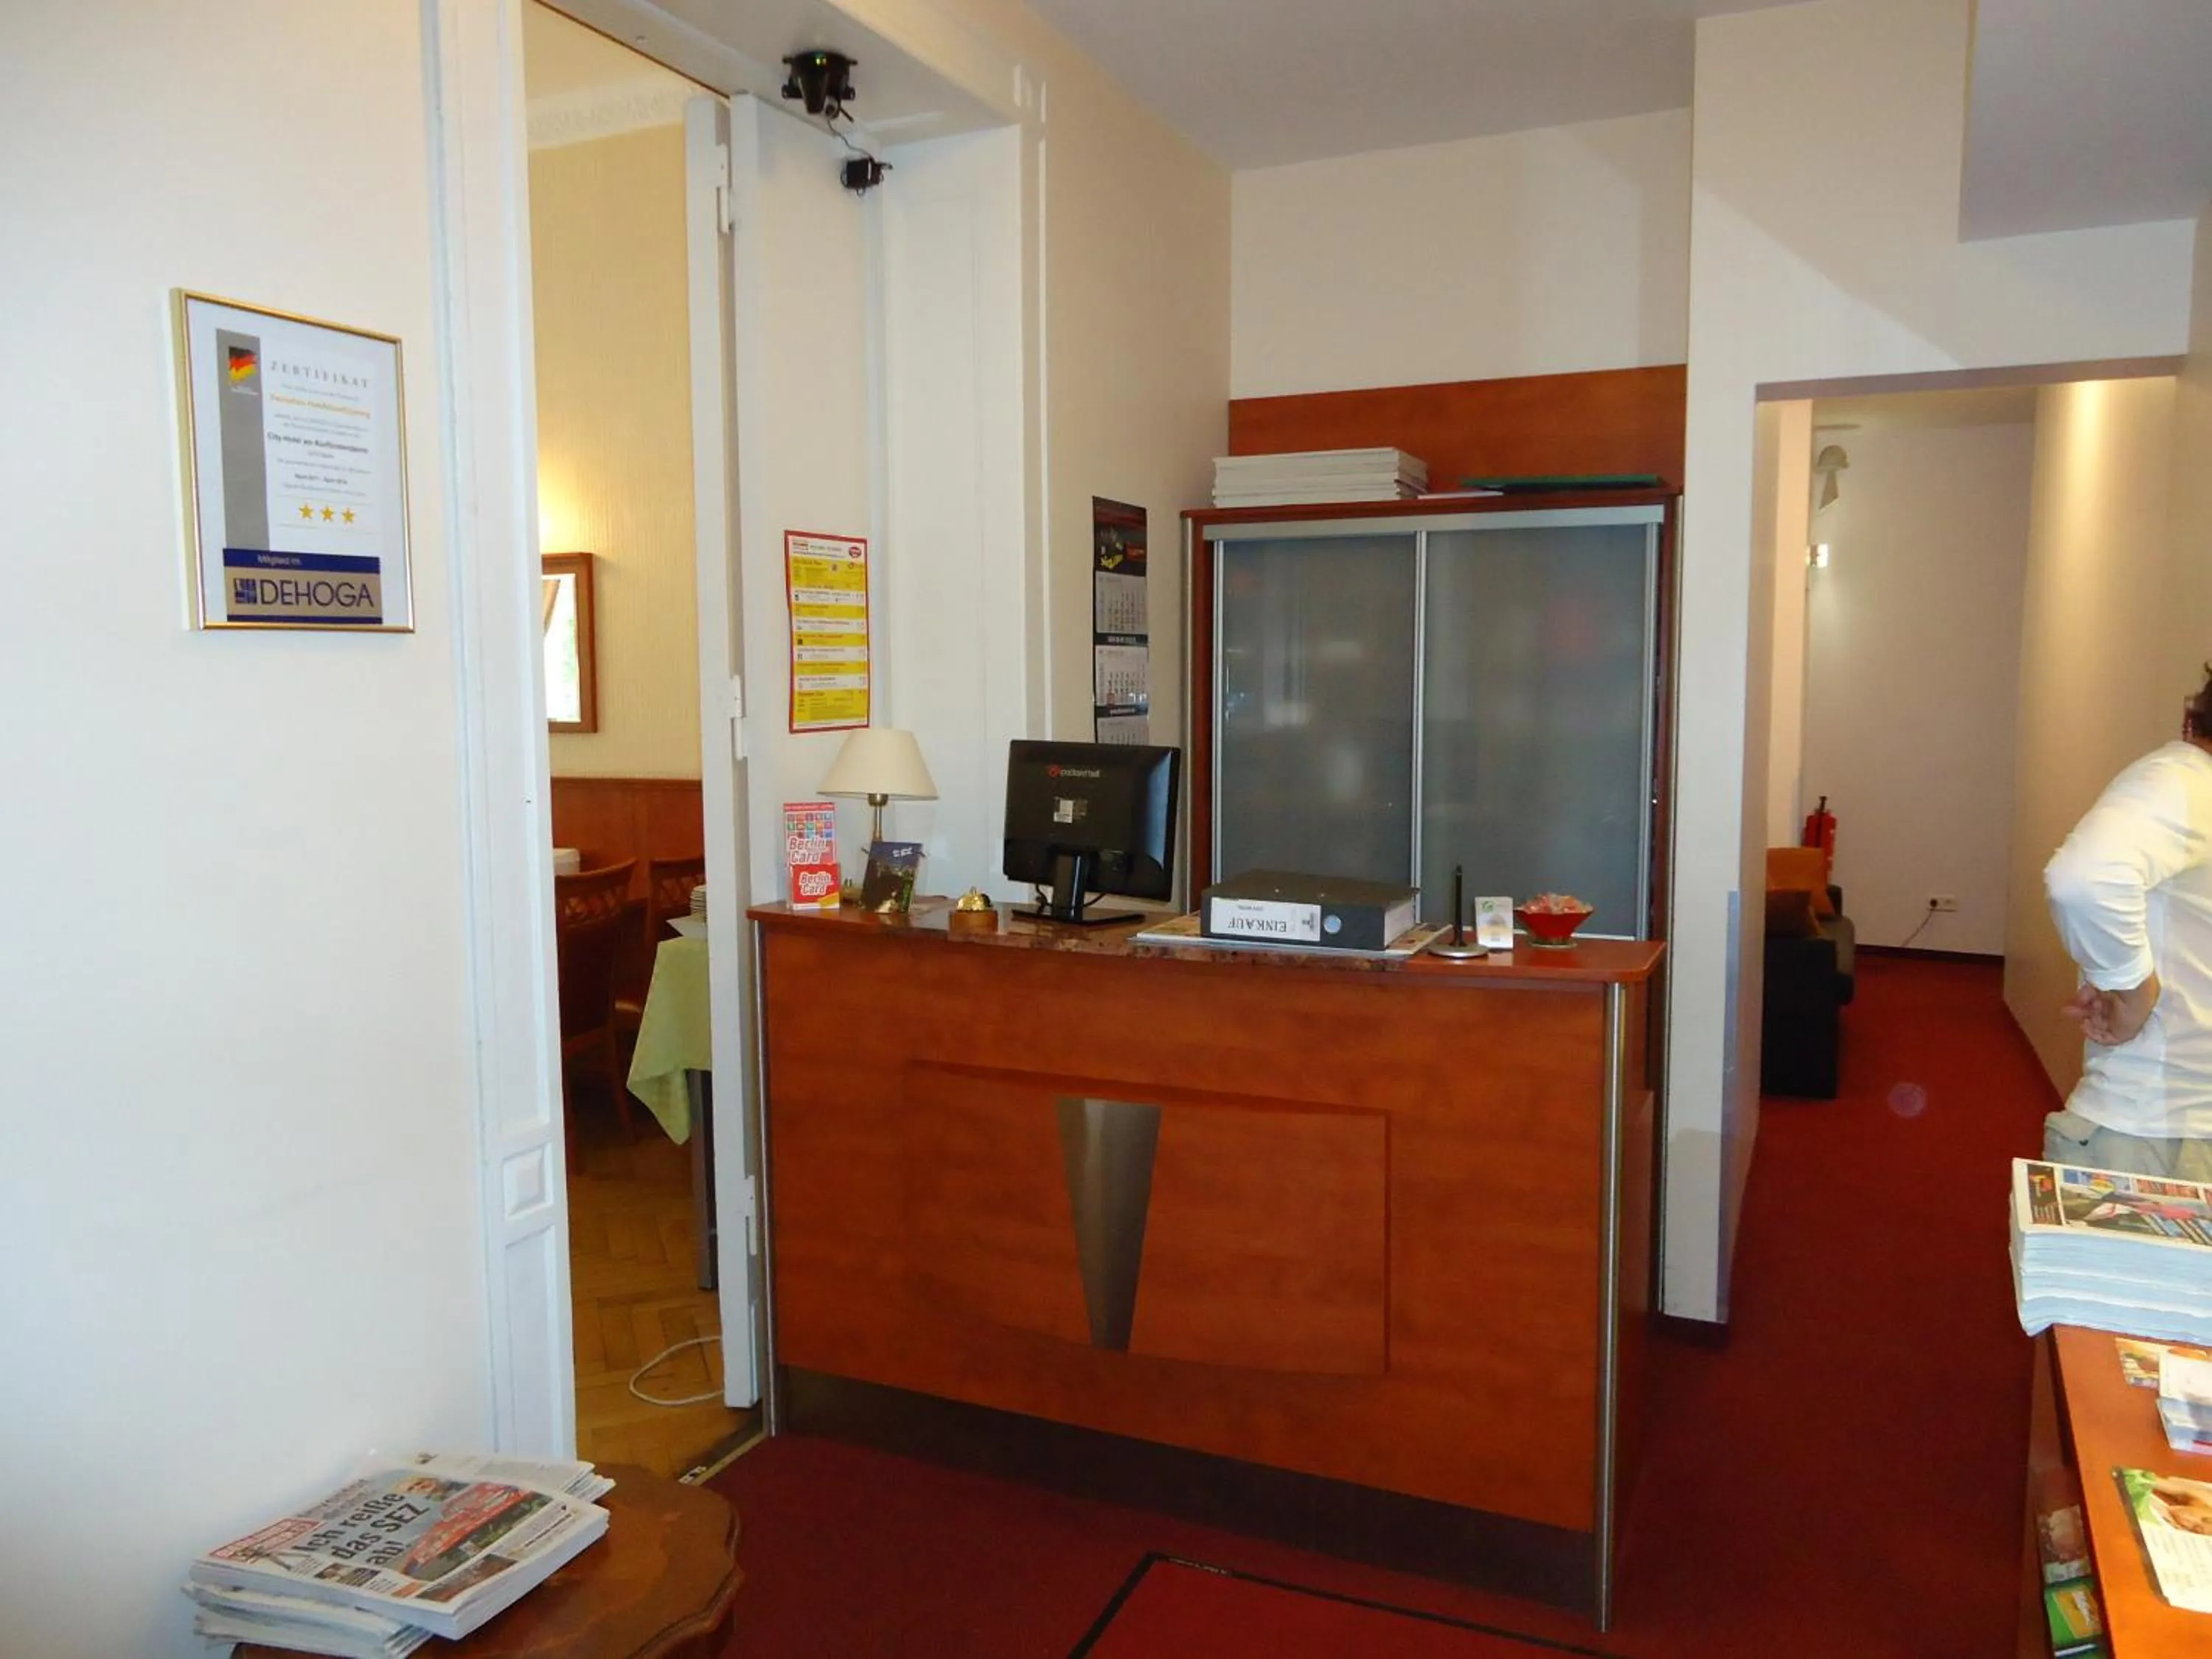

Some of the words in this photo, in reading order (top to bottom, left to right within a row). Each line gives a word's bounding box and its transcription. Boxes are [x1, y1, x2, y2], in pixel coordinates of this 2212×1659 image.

[260, 579, 375, 608] DEHOGA
[1228, 917, 1287, 933] EINKAUF
[291, 1528, 346, 1551] Ich
[339, 1492, 406, 1528] reiße
[331, 1532, 383, 1560] das
[370, 1502, 431, 1534] SEZ
